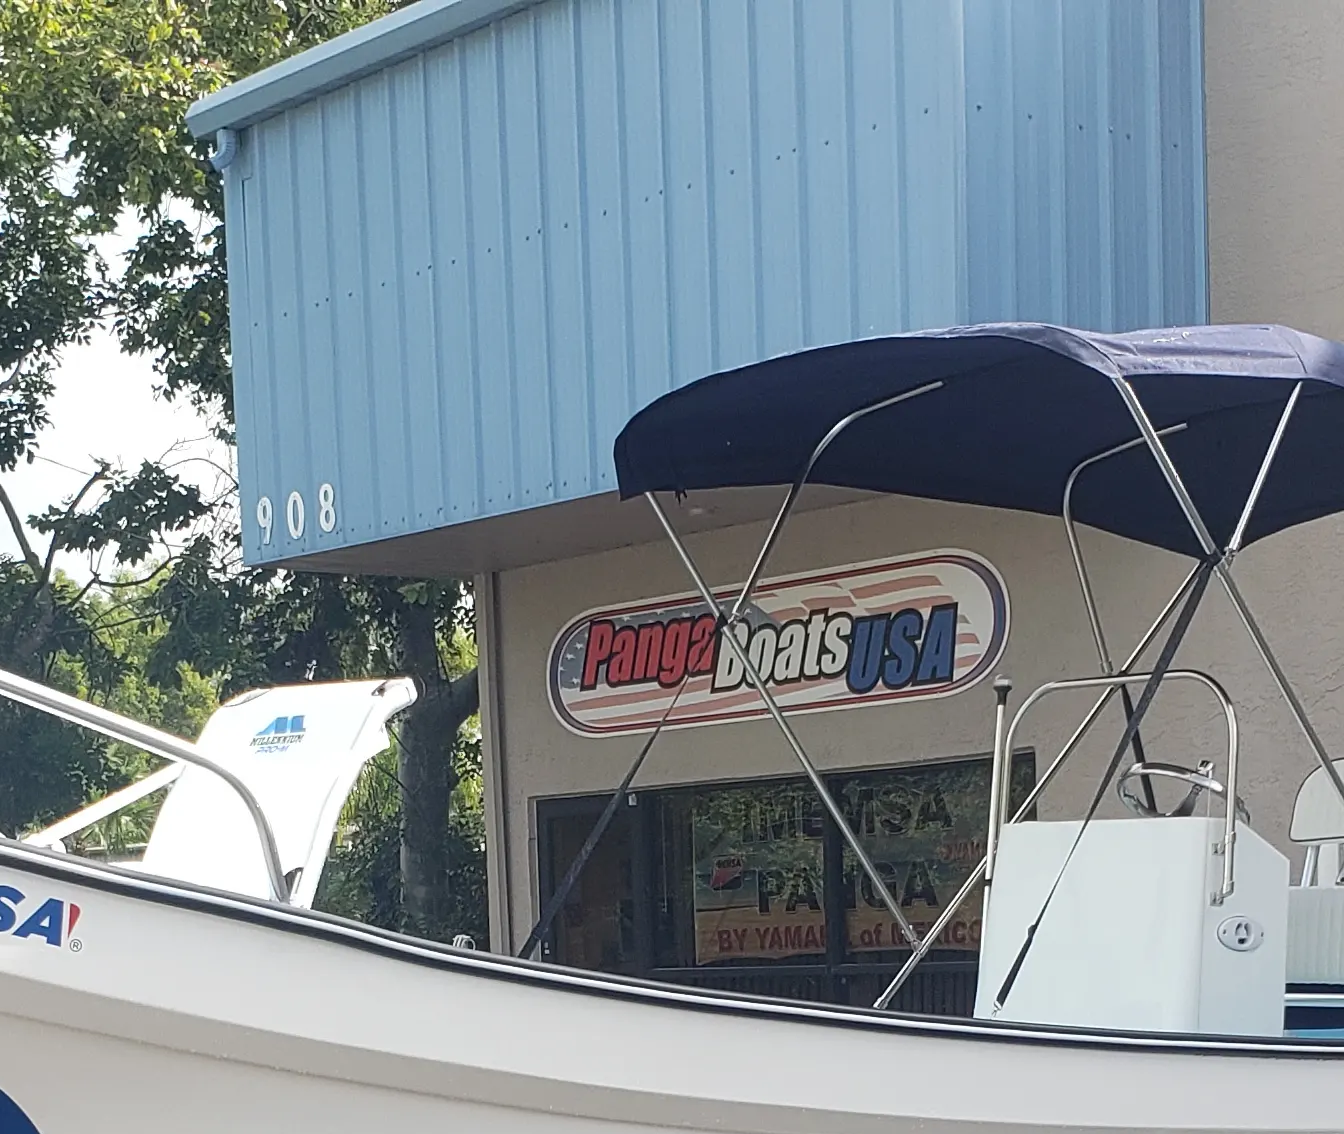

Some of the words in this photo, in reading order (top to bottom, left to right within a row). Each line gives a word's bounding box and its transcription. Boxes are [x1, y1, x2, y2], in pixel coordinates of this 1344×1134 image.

[257, 483, 336, 545] 908
[580, 611, 719, 692] Panga
[845, 601, 959, 694] USA
[717, 927, 747, 953] BY
[859, 922, 883, 946] of
[889, 919, 982, 946] MEICO
